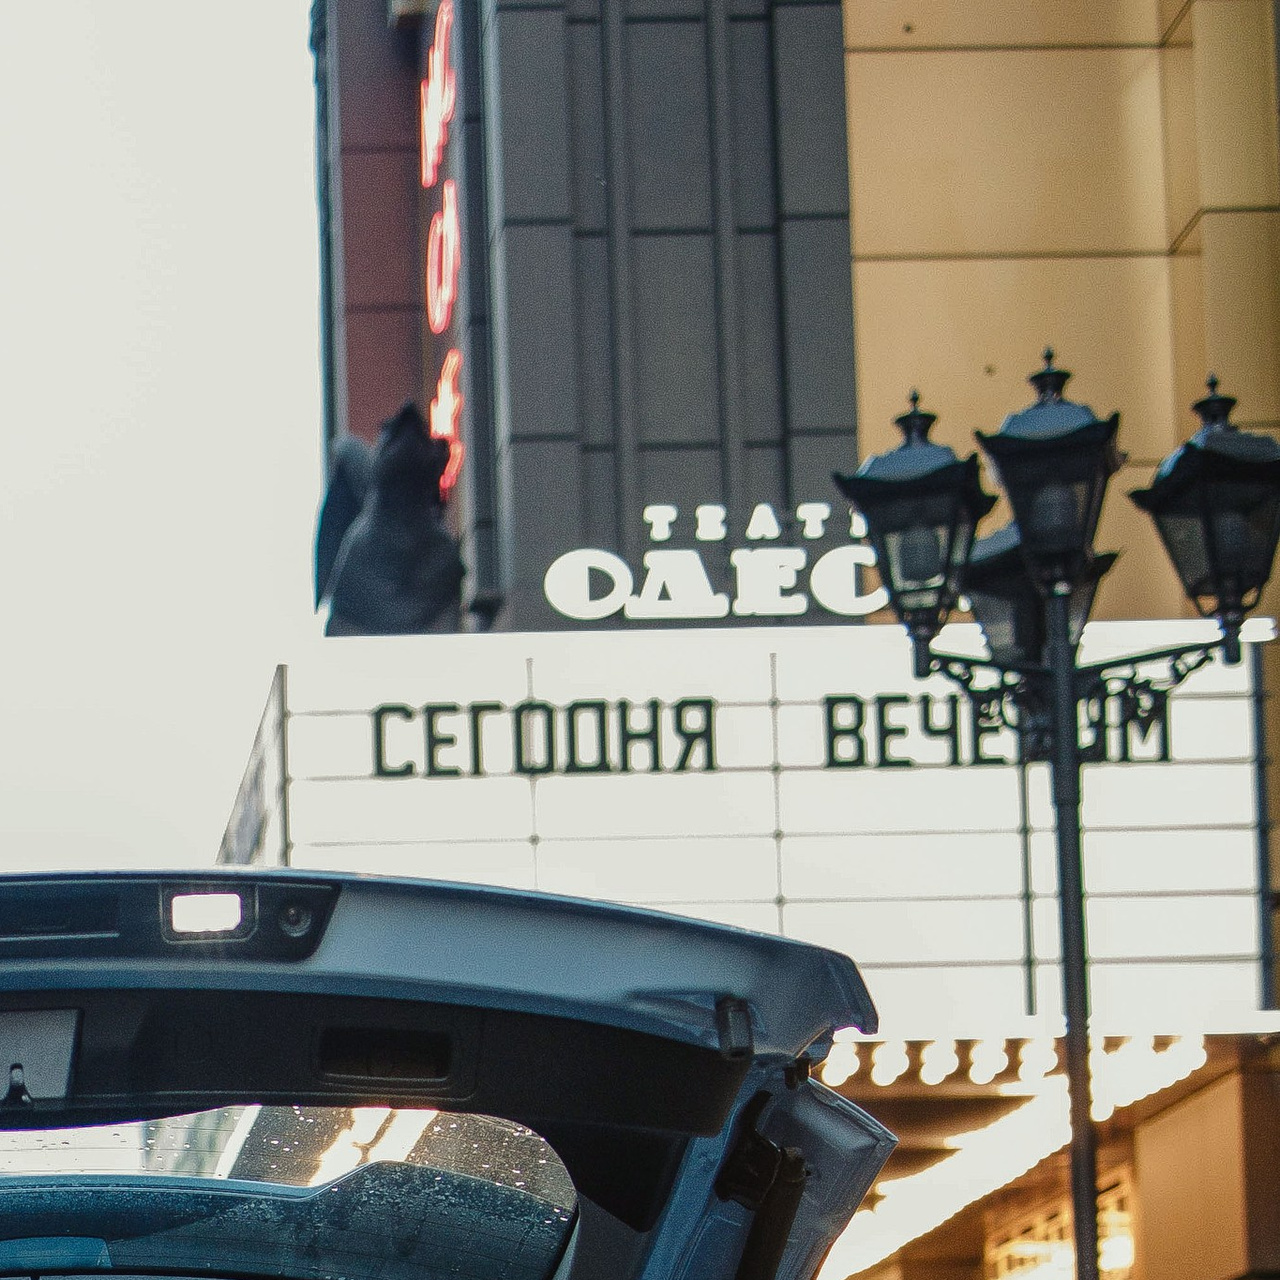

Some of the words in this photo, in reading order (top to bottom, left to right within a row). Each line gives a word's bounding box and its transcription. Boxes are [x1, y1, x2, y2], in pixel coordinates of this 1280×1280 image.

[544, 544, 972, 620] ОДЕС
[372, 697, 717, 778] СЕГОДНЯ
[822, 692, 1169, 767] ВЕЧЕМ
